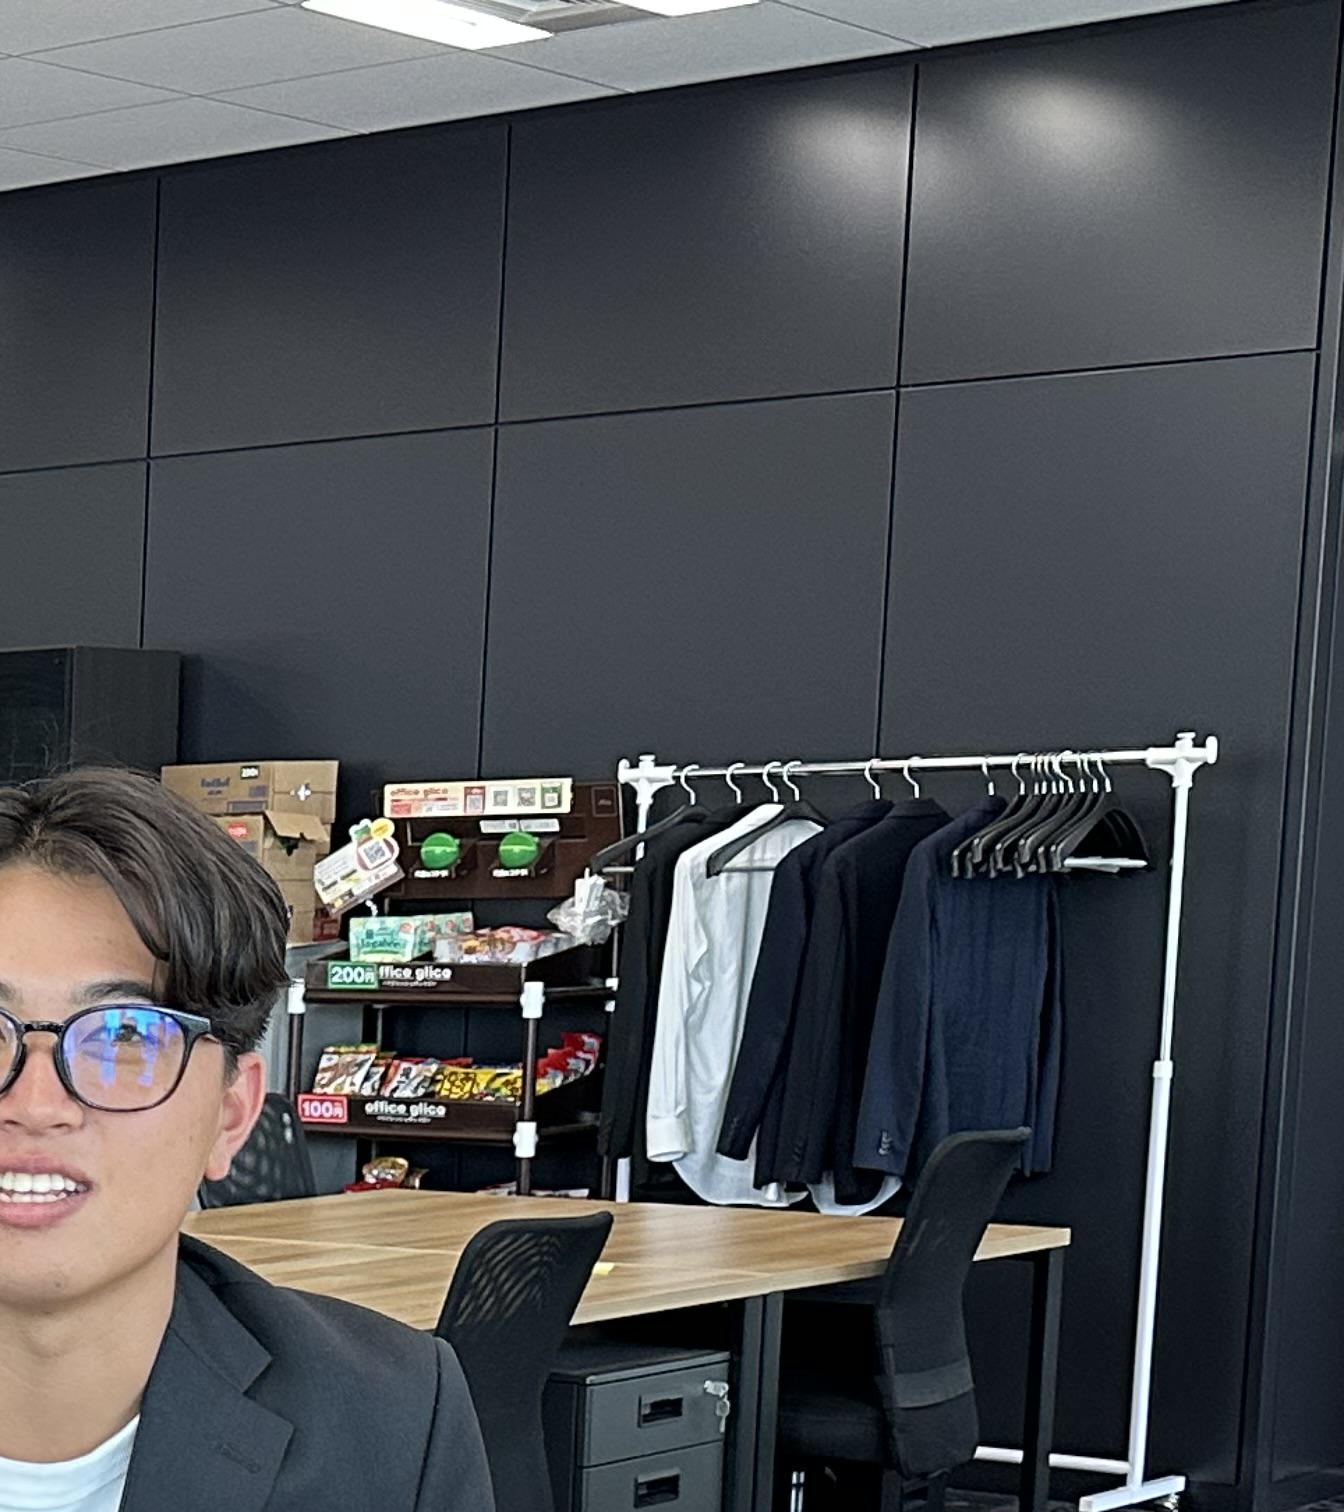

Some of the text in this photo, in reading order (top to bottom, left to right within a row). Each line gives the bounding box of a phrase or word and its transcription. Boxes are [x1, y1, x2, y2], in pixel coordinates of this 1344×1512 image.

[378, 965, 452, 981] ffice glico
[365, 1100, 446, 1117] office glico
